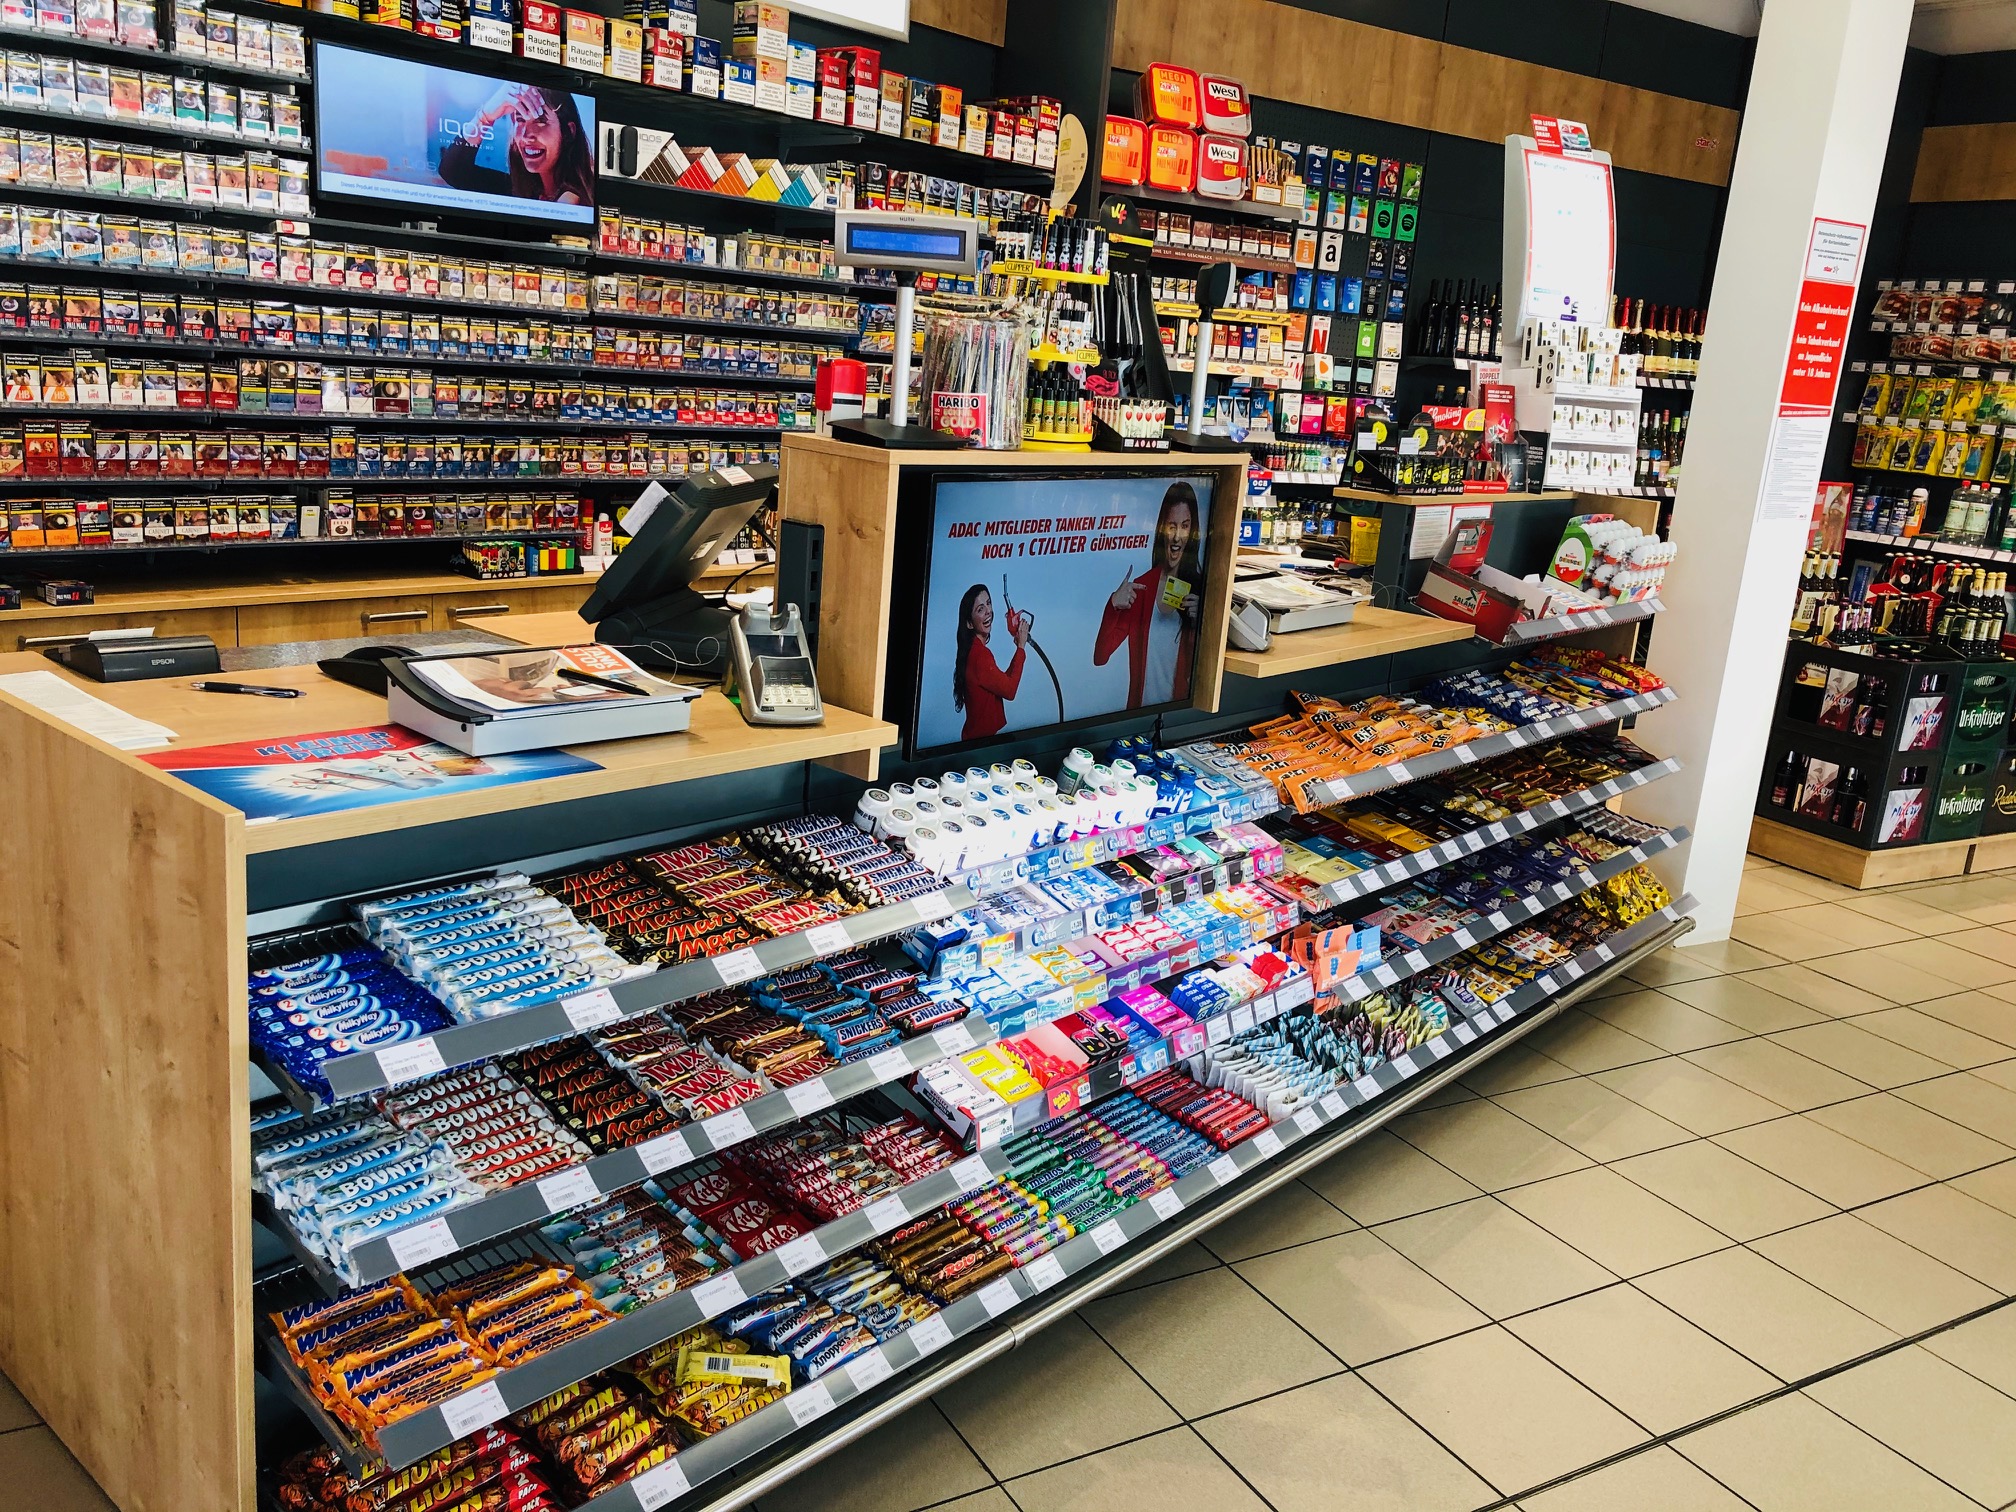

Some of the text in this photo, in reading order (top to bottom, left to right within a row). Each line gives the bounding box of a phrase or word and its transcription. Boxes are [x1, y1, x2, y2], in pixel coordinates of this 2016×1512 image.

[669, 10, 698, 23] Rauchen
[680, 22, 688, 30] ist
[525, 44, 560, 58] ist tödlich
[528, 34, 560, 49] Rauchen
[570, 44, 602, 58] Rauchen
[658, 45, 682, 57] RED BULL
[568, 54, 579, 63] ist
[657, 59, 682, 71] Rauchen
[659, 74, 679, 85] tödlich
[693, 67, 720, 80] Rauchen
[1160, 71, 1186, 84] MEGA
[696, 84, 717, 96] tödlich
[823, 91, 846, 103] Rauchen
[855, 93, 879, 106] Rauchen
[1211, 84, 1238, 98] West
[825, 107, 843, 118] tödlich
[856, 109, 876, 120] tödlich
[1040, 115, 1059, 126] BREAK
[439, 117, 494, 141] IQOS
[1020, 125, 1036, 133] BREAK
[1162, 133, 1184, 145] GIGA
[1211, 146, 1237, 160] West
[1006, 261, 1032, 273] CLIPPER
[1800, 302, 1849, 317] Kein Alkoholverkauf
[1816, 320, 1827, 330] und
[1796, 334, 1840, 348] kein Tabakverkauf
[1804, 352, 1833, 364] Jugendliche
[1479, 372, 1500, 380] DOPPELT
[1793, 368, 1832, 379] unter 18 Jahren
[18, 389, 31, 400] HB
[54, 391, 67, 401] HB
[938, 396, 980, 410] HARIBO
[1254, 400, 1265, 411] blu
[1428, 405, 1463, 426] Smoking
[940, 416, 977, 430] GOLD
[1252, 479, 1268, 488] OCB
[949, 515, 1126, 538] ADAC MITGLIEDER TANKEN JETZT
[981, 533, 1149, 560] NOCH 1 CT/LITER GÜNSTIGER!
[1453, 595, 1476, 611] SALAMI
[151, 658, 175, 666] EPSON
[565, 647, 606, 670] STOP
[1311, 709, 1338, 726] BiFi
[1333, 720, 1356, 733] BiFi
[255, 730, 391, 757] KLEINER
[287, 738, 391, 763] PREIS!
[1431, 733, 1451, 749] BiFi
[787, 815, 841, 839] SNICKERS
[806, 824, 860, 847] SNICKERS
[1149, 828, 1167, 838] Extra
[643, 841, 717, 873] TWIX
[834, 845, 888, 867] SNICKERS
[851, 852, 906, 876] SNICKERS
[563, 860, 629, 892] Mars
[869, 862, 925, 886] SNICKERS
[1019, 861, 1039, 876] Extra
[681, 872, 752, 902] TWIX
[590, 885, 660, 918] Mars
[704, 887, 775, 912] TWIX
[606, 896, 676, 928] Mars
[628, 904, 697, 936] Mars
[756, 899, 821, 928] TWIX
[1097, 911, 1118, 923] Extra
[665, 911, 738, 946] Mars
[433, 930, 525, 960] BOUNTY
[679, 925, 751, 960] Mars
[454, 941, 543, 971] BOUNTY
[459, 953, 550, 986] BOUNTY
[777, 967, 821, 988] SNICKERS
[471, 966, 565, 998] BOUNTY
[283, 999, 293, 1009] 2
[307, 985, 347, 1004] MilkyWay
[881, 992, 933, 1016] SNICKERS
[296, 1013, 306, 1023] 2
[317, 998, 359, 1018] MilkyWay
[913, 1000, 963, 1024] SNICKERS
[315, 1027, 325, 1037] 2
[337, 1011, 378, 1032] MilkyWay
[839, 1018, 884, 1043] SNICKERS
[360, 1023, 399, 1044] MilkyWay
[999, 1042, 1025, 1067] Hubba
[538, 1050, 598, 1087] Mars
[639, 1048, 709, 1088] TWIX
[661, 1063, 732, 1101] TWIX
[572, 1079, 632, 1115] Mars
[692, 1077, 763, 1115] TWIX
[434, 1094, 515, 1132] BOUNTY
[586, 1089, 649, 1130] Mars
[447, 1107, 528, 1146] BOUNTY
[606, 1105, 668, 1145] Mars
[1037, 1114, 1066, 1132] mentos
[458, 1121, 538, 1161] BOUNTY
[1072, 1139, 1102, 1159] mentos
[494, 1144, 574, 1183] BOUNTY
[338, 1153, 431, 1200] BOUNTY
[1030, 1166, 1063, 1189] mentos
[1113, 1167, 1148, 1188] mentos
[686, 1174, 730, 1208] KitKat
[725, 1201, 771, 1232] KitKat
[1063, 1197, 1095, 1220] mentos
[895, 1220, 928, 1241] Rolo
[988, 1212, 1027, 1235] mentos
[755, 1224, 798, 1255] KitKat
[1014, 1238, 1044, 1258] mentos
[944, 1253, 976, 1277] Rolo
[771, 1308, 808, 1341] Knoppers
[872, 1306, 899, 1326] MilkyWay
[297, 1299, 408, 1356] WUNDERBAR
[343, 1331, 461, 1392] WUNDERBAR
[811, 1335, 851, 1370] Knoppers
[531, 1381, 582, 1425] LION
[569, 1386, 617, 1430] LION
[484, 1424, 498, 1440] 2
[590, 1405, 637, 1450] LION
[486, 1433, 507, 1452] PACK
[606, 1419, 652, 1467] LION
[509, 1453, 531, 1472] PACK
[389, 1447, 454, 1501] LION
[410, 1465, 477, 1512] LION
[517, 1481, 539, 1501] PACK
